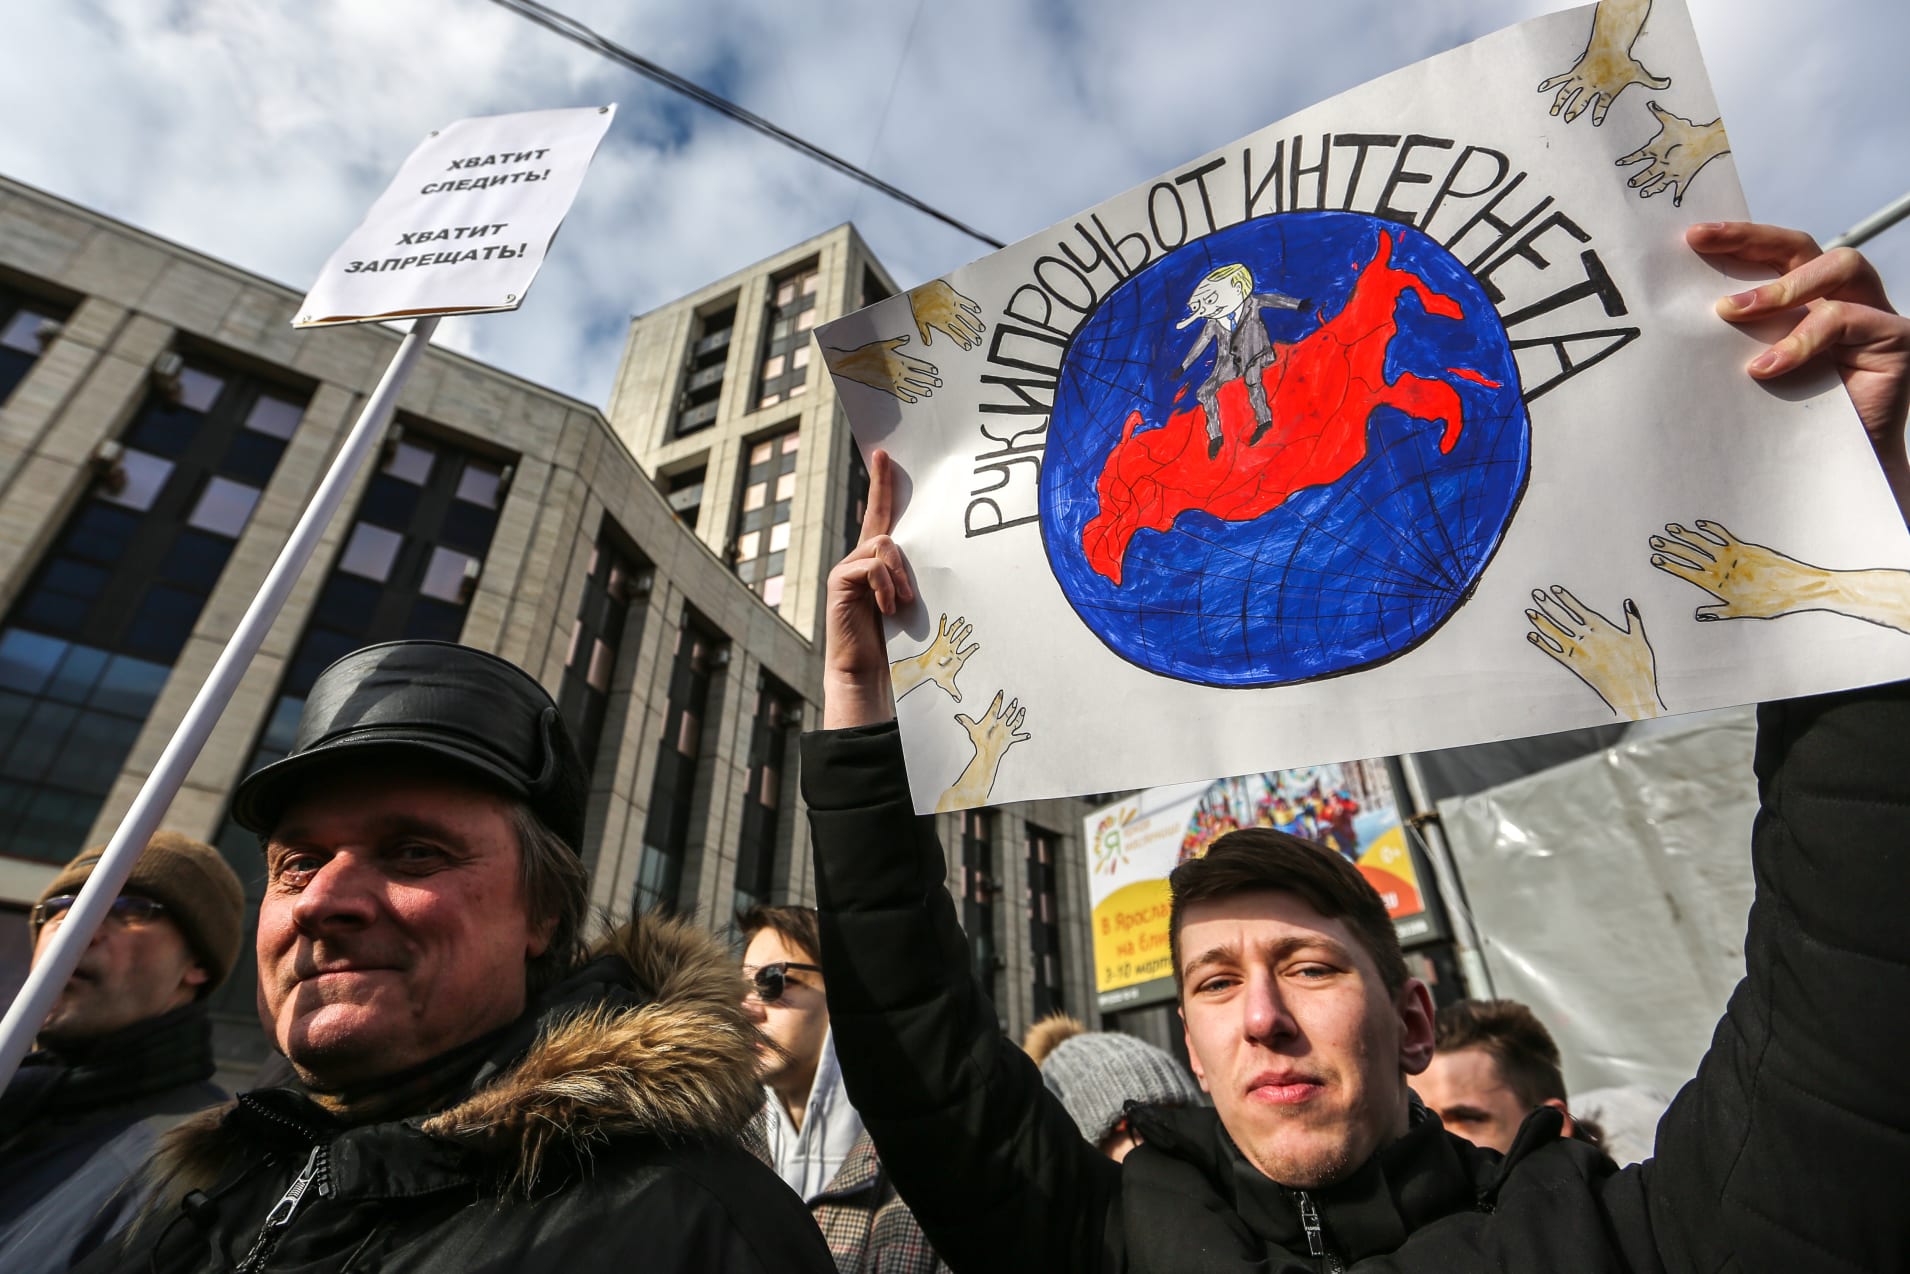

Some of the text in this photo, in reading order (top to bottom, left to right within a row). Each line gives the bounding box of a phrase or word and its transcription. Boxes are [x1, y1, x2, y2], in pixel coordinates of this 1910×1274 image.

[446, 148, 551, 171] ХВАТИТ
[420, 169, 552, 195] СЛЕДИТЬ!
[395, 223, 509, 246] ХВАТИТ
[344, 242, 528, 274] ЗАПРЕЩАТЬ!
[964, 132, 1642, 539] РУКИ ПРОЧЬ ОТ ИНТЕРНЕТА
[1101, 900, 1173, 936] В Яросла
[1116, 940, 1136, 956] на
[1135, 955, 1172, 977] март
